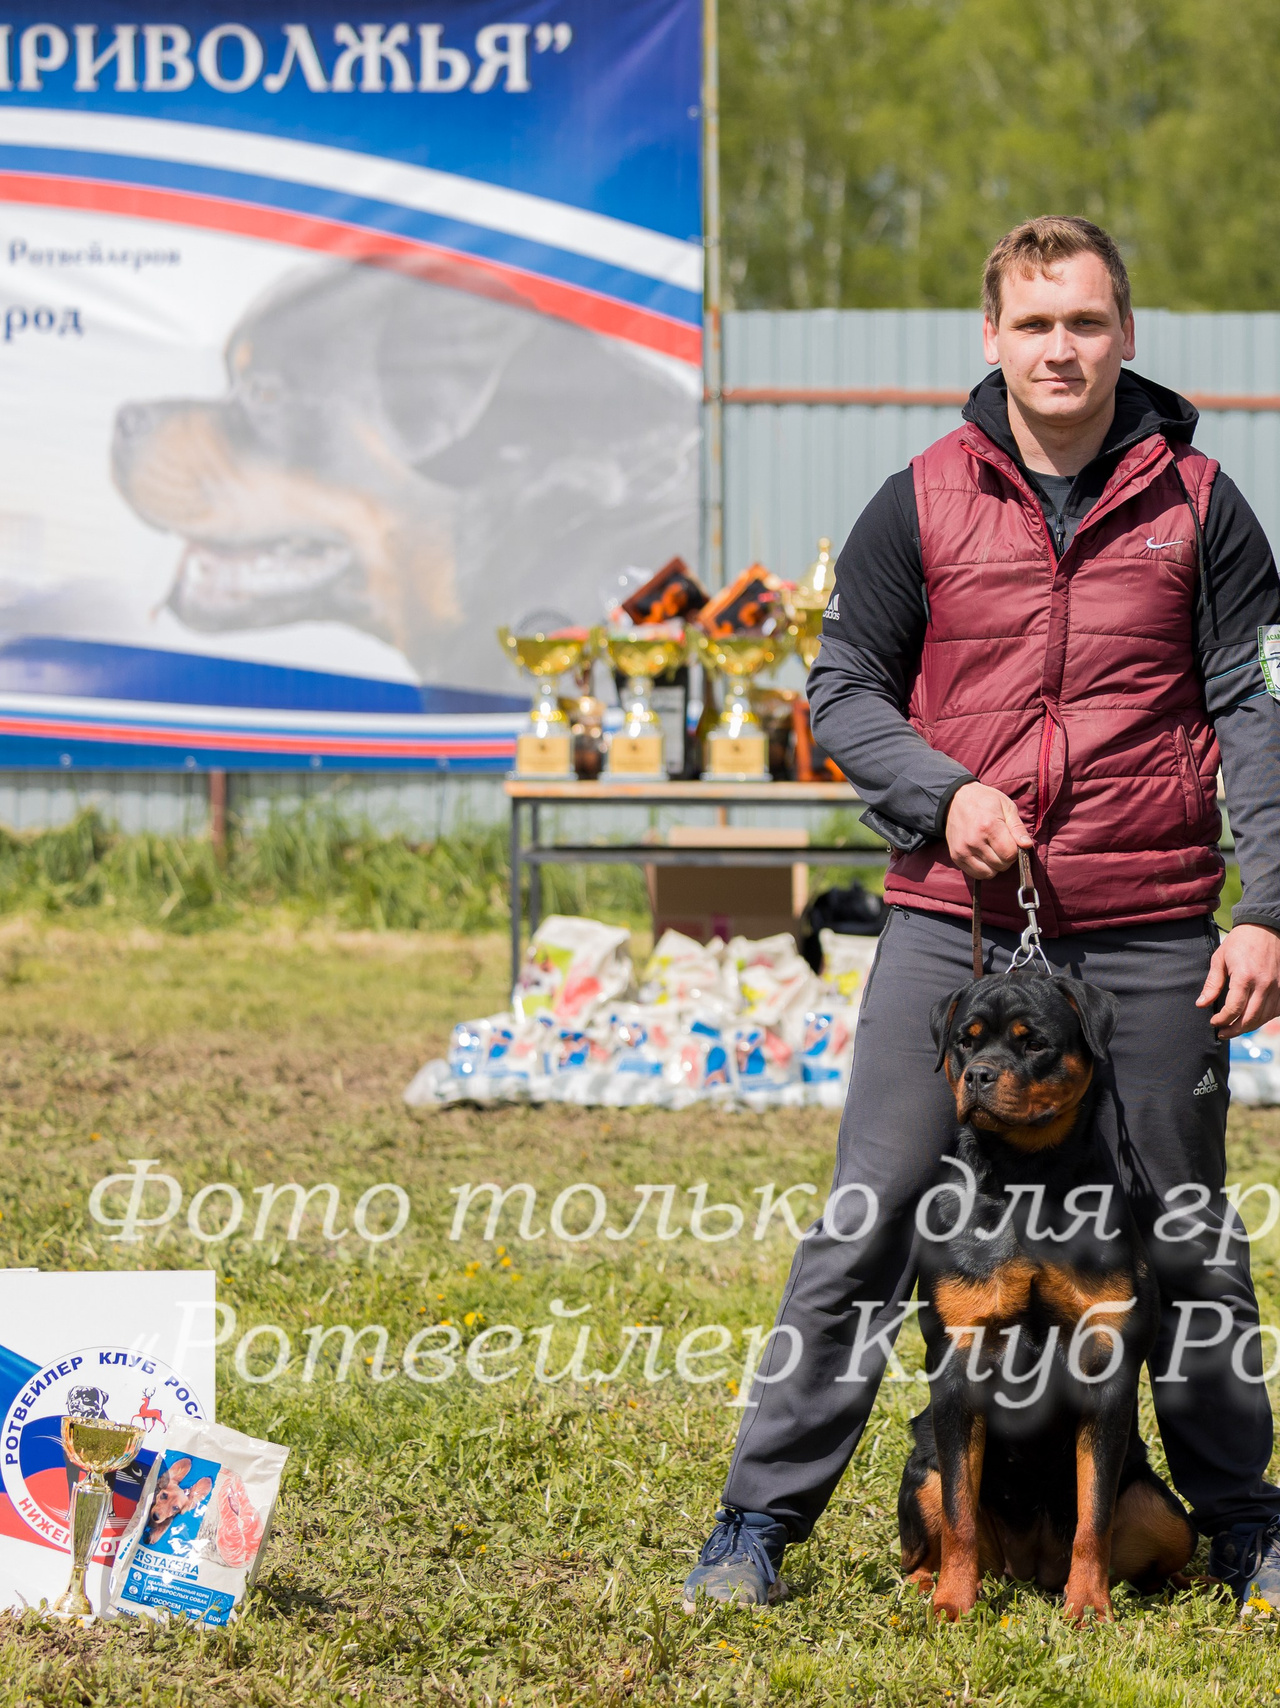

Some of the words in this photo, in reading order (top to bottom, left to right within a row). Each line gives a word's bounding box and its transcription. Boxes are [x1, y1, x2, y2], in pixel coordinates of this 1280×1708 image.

[0, 22, 573, 94] РИВОЛЖЬЯ”
[1193, 1083, 1218, 1096] adidas
[5, 1356, 83, 1465] РОТВЕЙЛЕР
[99, 1352, 157, 1375] КЛУБ
[158, 1588, 189, 1600] ВЗРОСЛЫХ
[189, 1596, 208, 1605] СОБАК
